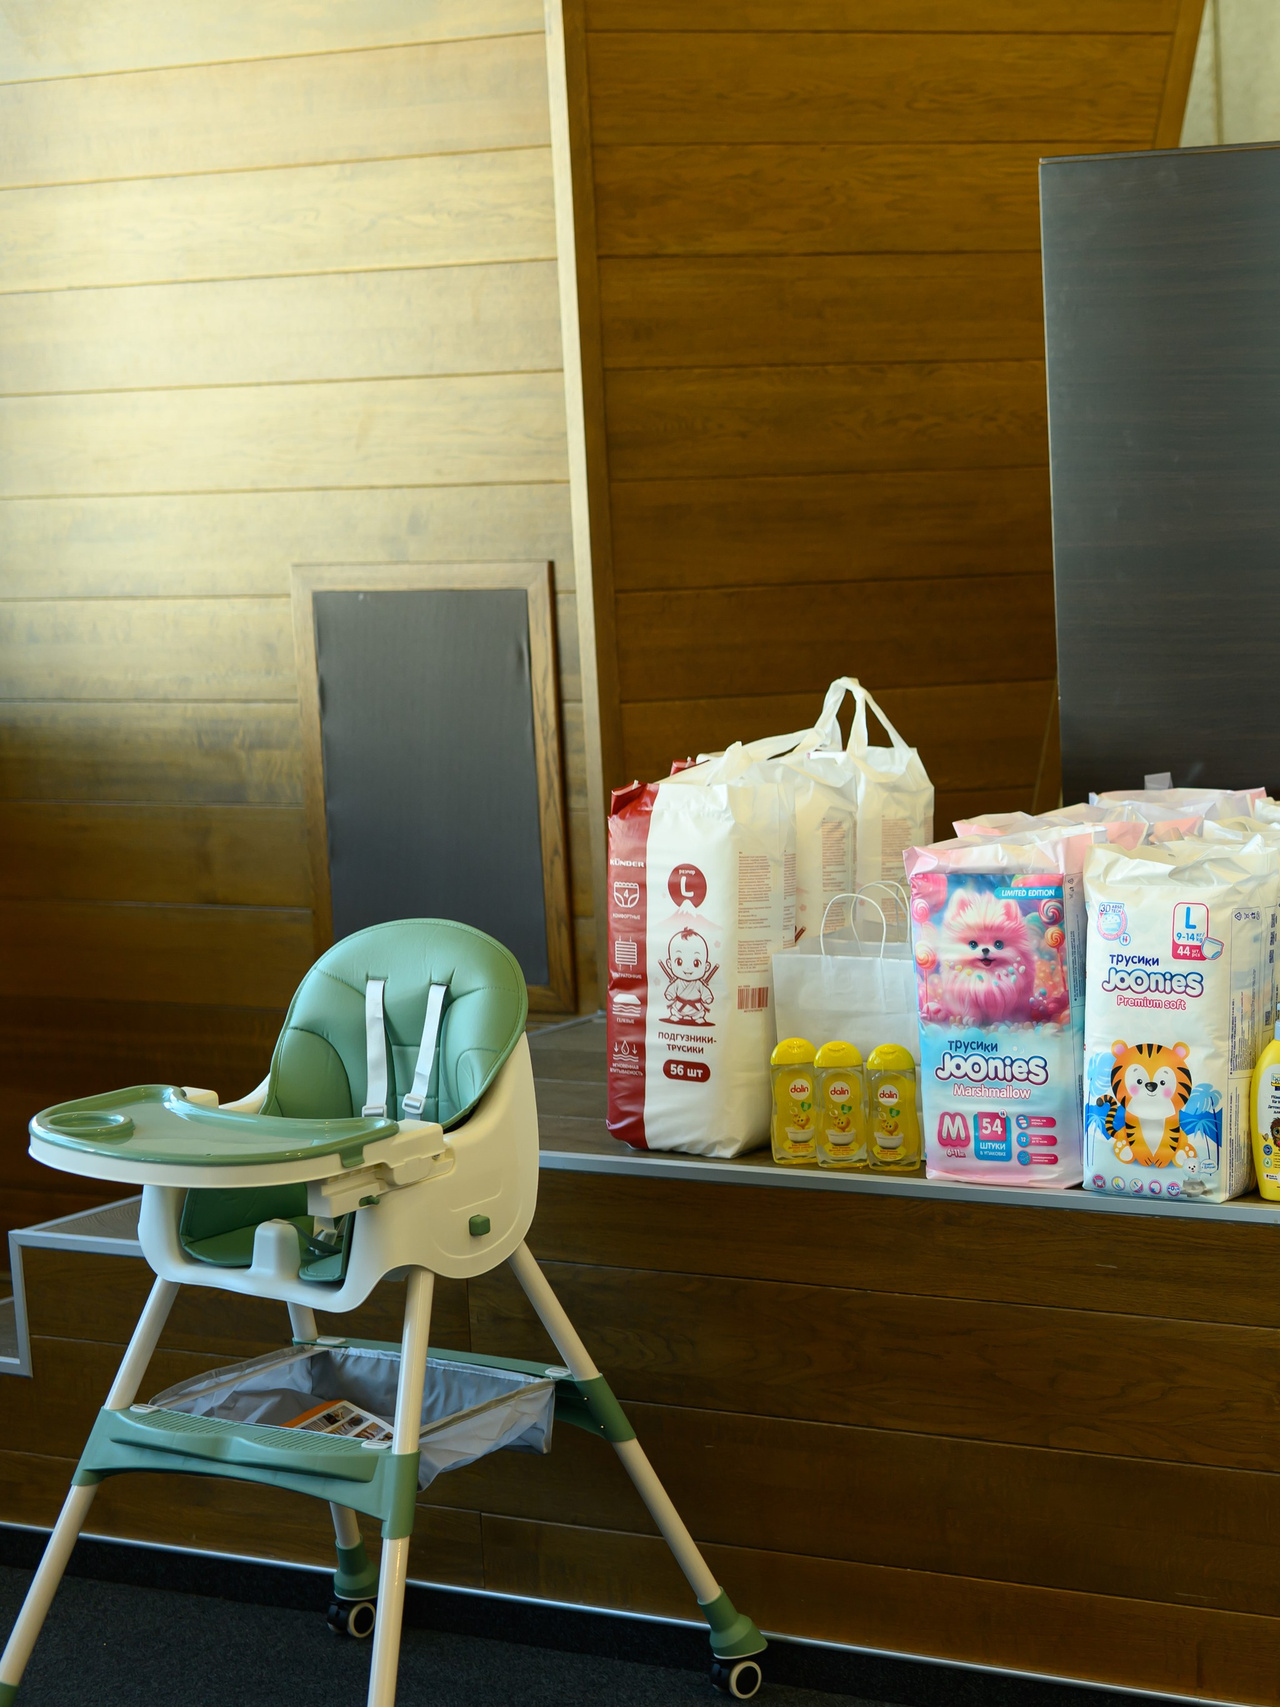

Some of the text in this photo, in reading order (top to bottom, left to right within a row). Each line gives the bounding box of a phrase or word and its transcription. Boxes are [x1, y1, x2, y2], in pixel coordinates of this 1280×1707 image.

[610, 858, 645, 868] KÜNDER
[680, 876, 694, 898] L
[1001, 889, 1055, 897] LIMITED EDITION
[1100, 903, 1111, 914] 3D
[1185, 906, 1197, 929] L
[1176, 932, 1195, 941] 9-14
[1177, 945, 1190, 956] 44
[1109, 953, 1160, 967] трусики
[1116, 995, 1187, 1010] Premium soft
[658, 1031, 717, 1045] ПОДГУЗНИКИ-
[666, 1043, 704, 1055] ТРУСИКИ
[947, 1040, 998, 1053] трусики
[670, 1063, 704, 1078] 56 шт
[790, 1084, 809, 1094] dalin
[829, 1087, 849, 1097] dalin
[878, 1090, 898, 1100] dalin
[953, 1083, 1031, 1099] Marshmallow
[941, 1115, 966, 1140] M
[981, 1118, 1003, 1135] 54
[980, 1141, 1006, 1150] ШТУКИ
